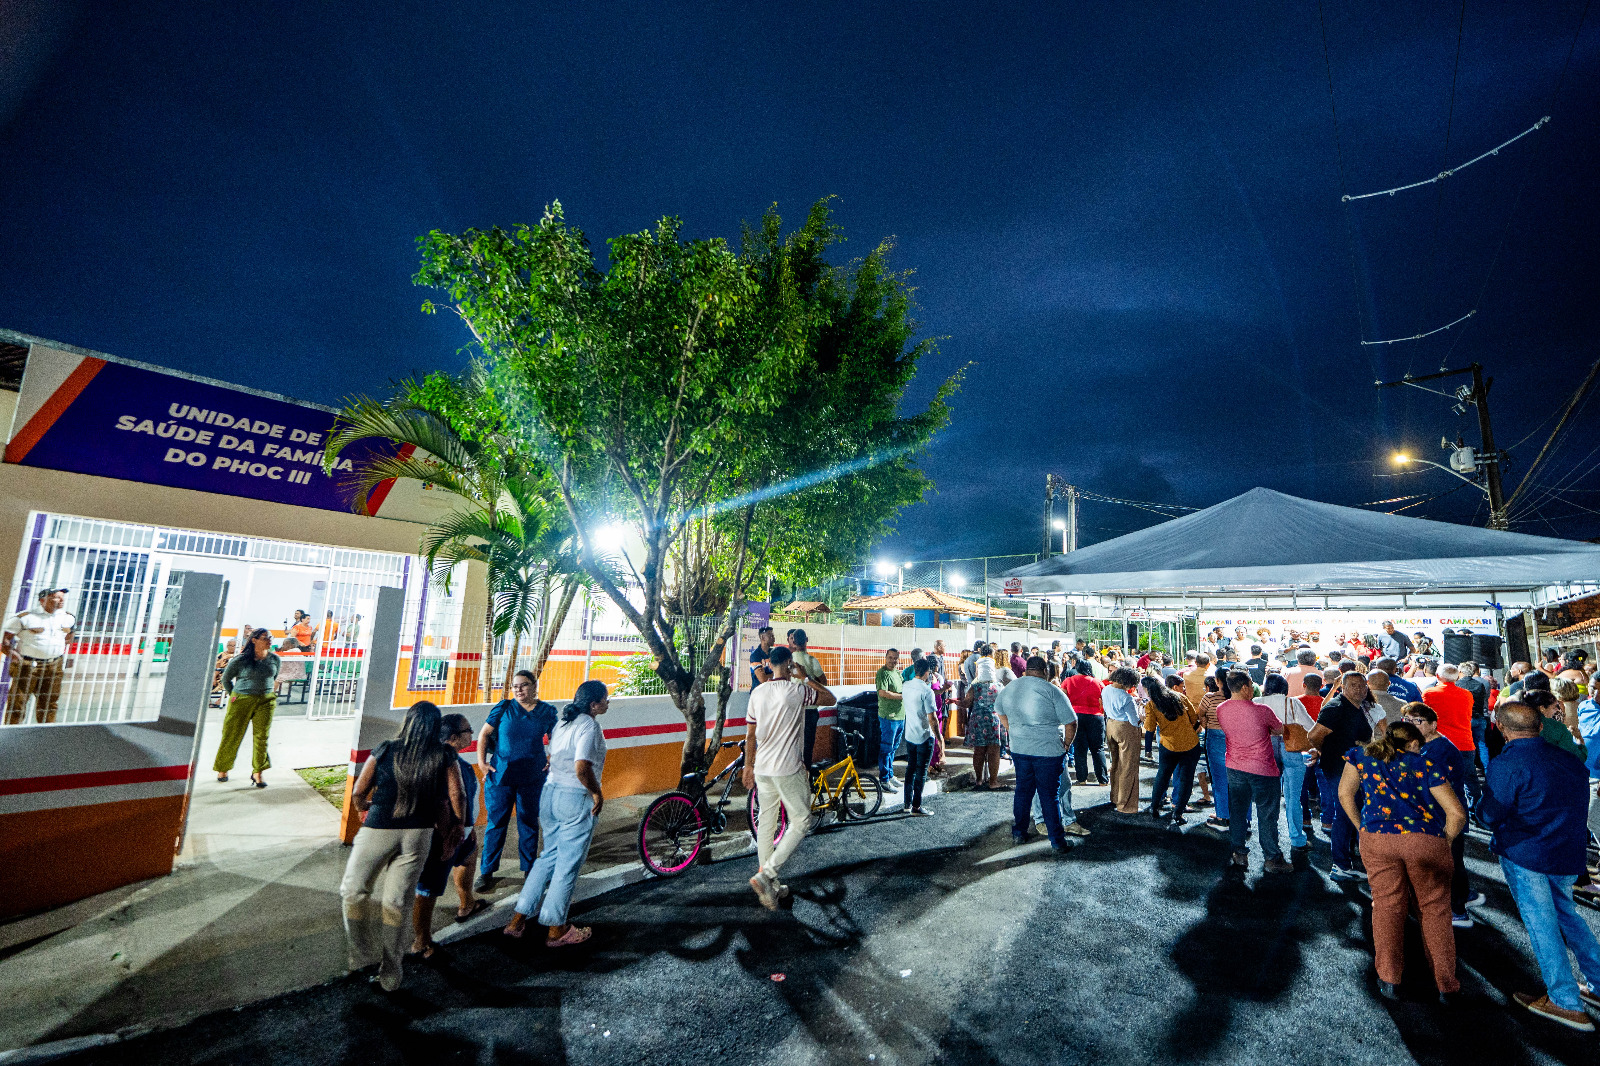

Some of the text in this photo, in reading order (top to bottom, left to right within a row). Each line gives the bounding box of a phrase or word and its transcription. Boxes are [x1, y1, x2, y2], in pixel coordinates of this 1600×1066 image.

[114, 415, 214, 446] SAÚDE
[218, 435, 256, 454] DA
[168, 402, 323, 446] UNIDADE DE
[163, 447, 312, 485] DO PHOC III
[1439, 618, 1492, 626] CAMAÇARI
